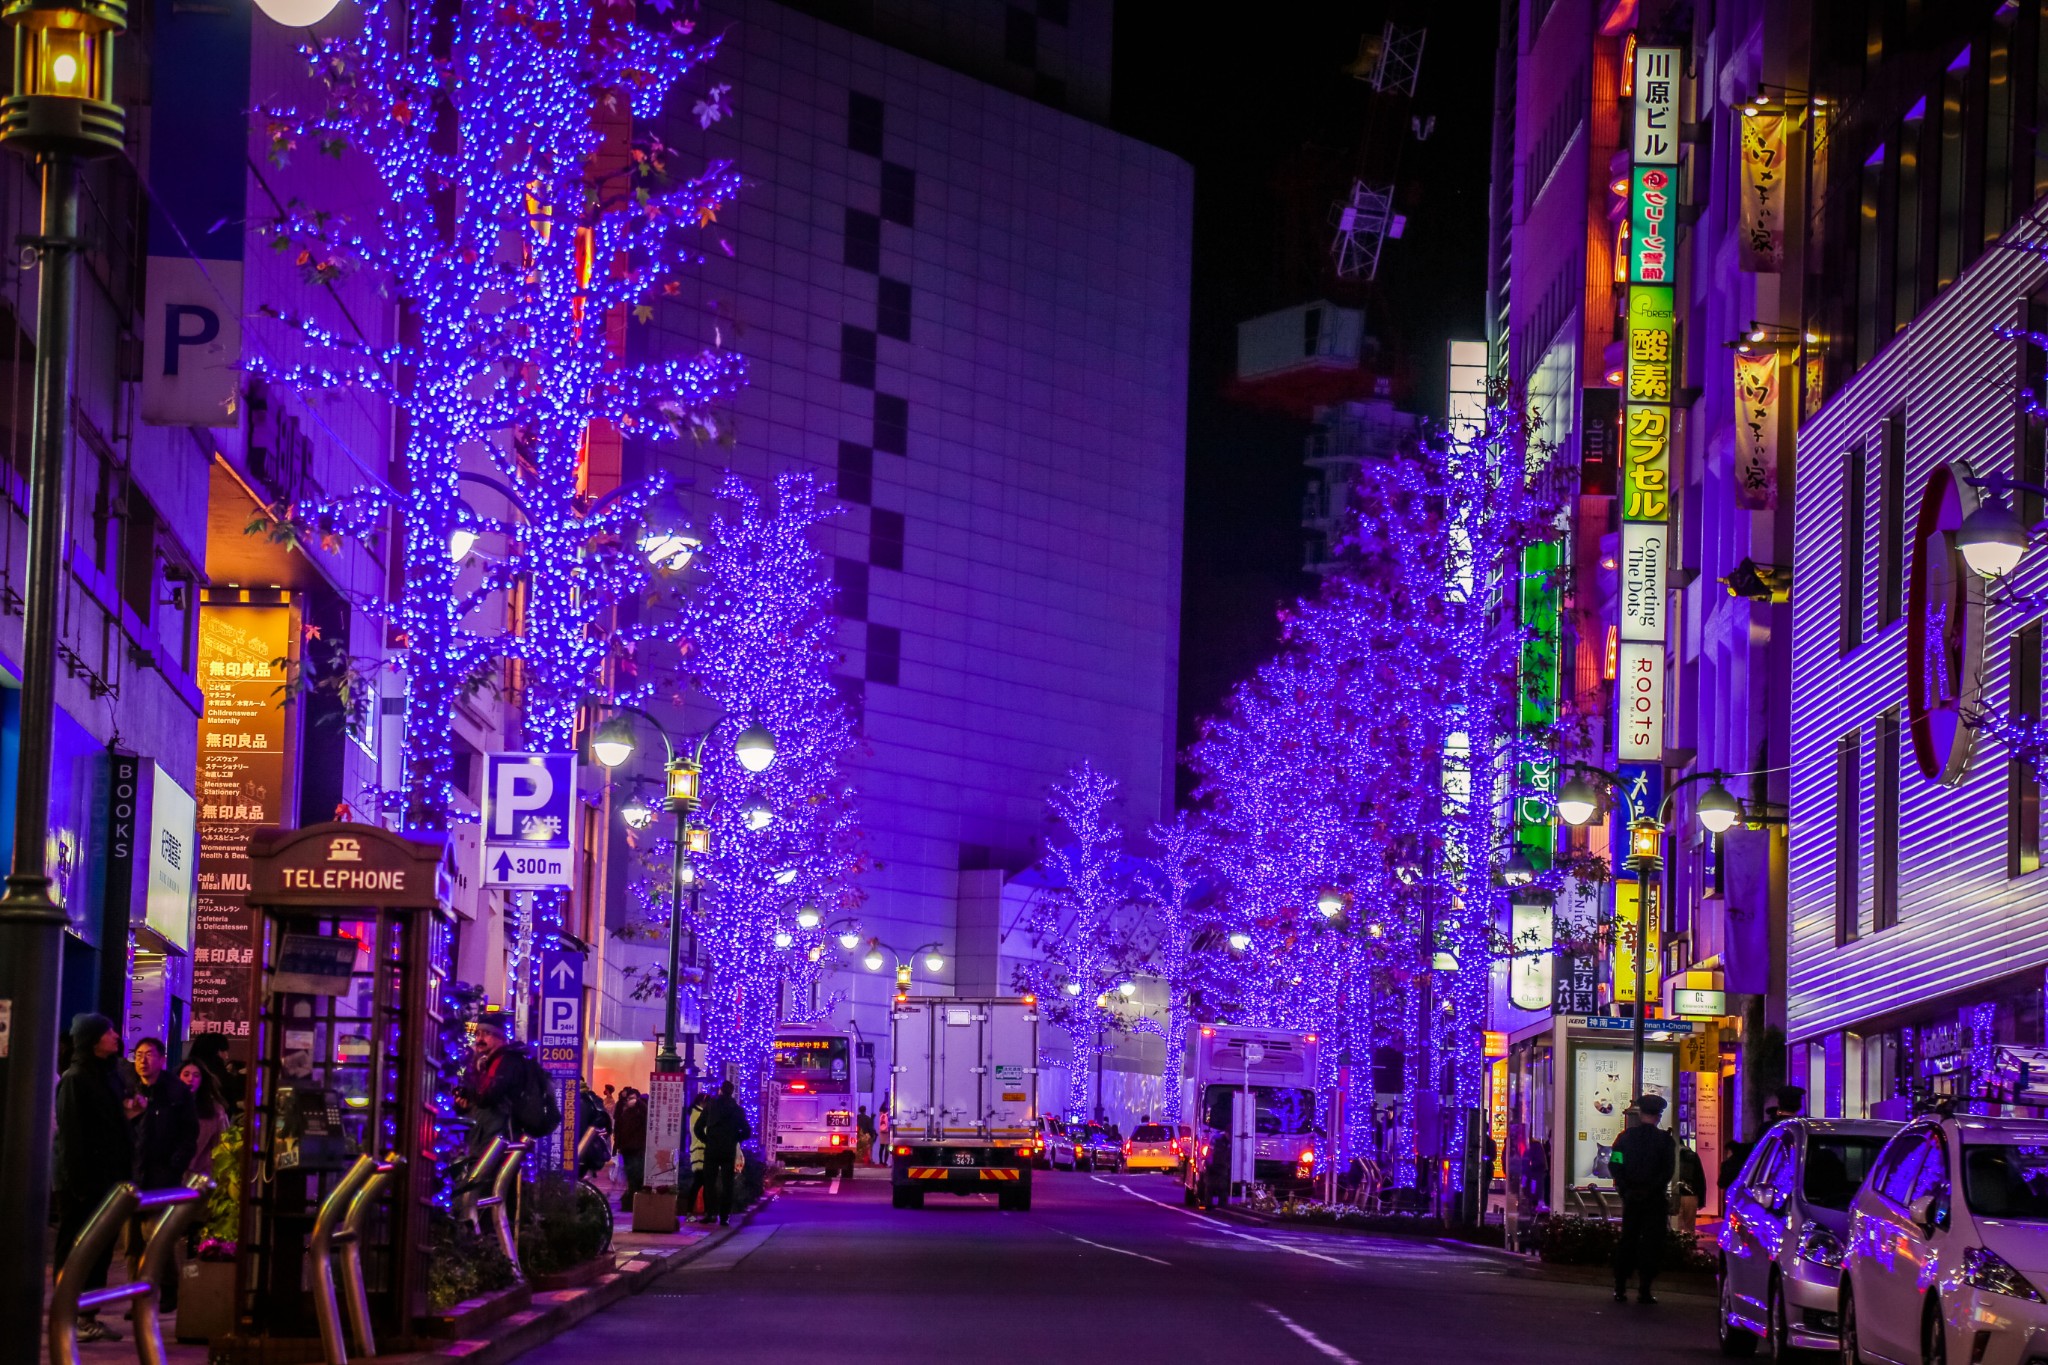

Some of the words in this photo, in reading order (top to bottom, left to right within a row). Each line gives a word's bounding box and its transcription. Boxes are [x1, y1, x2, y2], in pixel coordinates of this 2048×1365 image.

[1644, 54, 1670, 156] 川原ビル
[162, 303, 220, 376] P
[1584, 419, 1604, 463] little
[1628, 546, 1644, 577] The
[1639, 537, 1661, 627] Connecting
[1627, 580, 1644, 617] Dots
[209, 661, 271, 677] 無印良品
[207, 709, 258, 717] Childrenswear
[207, 717, 241, 726] Maternity
[206, 733, 268, 749] 無印良品
[204, 788, 240, 797] Stationery
[495, 763, 554, 835] P
[114, 764, 133, 858] BOOKS
[202, 804, 264, 820] 無印良品
[520, 815, 562, 835] 公共
[516, 858, 562, 875] 300m
[197, 872, 215, 882] Café
[282, 868, 405, 891] TELEPHONE
[201, 882, 220, 891] Meal
[203, 923, 248, 931] Delicatessen
[194, 948, 254, 963] 無印良品
[193, 988, 219, 996] Bicycle
[216, 996, 239, 1004] goods
[551, 1001, 573, 1031] P
[1589, 1019, 1635, 1029] 神南一丁目
[190, 1020, 250, 1036] 無印良品
[1662, 1022, 1692, 1031] 1-Chome
